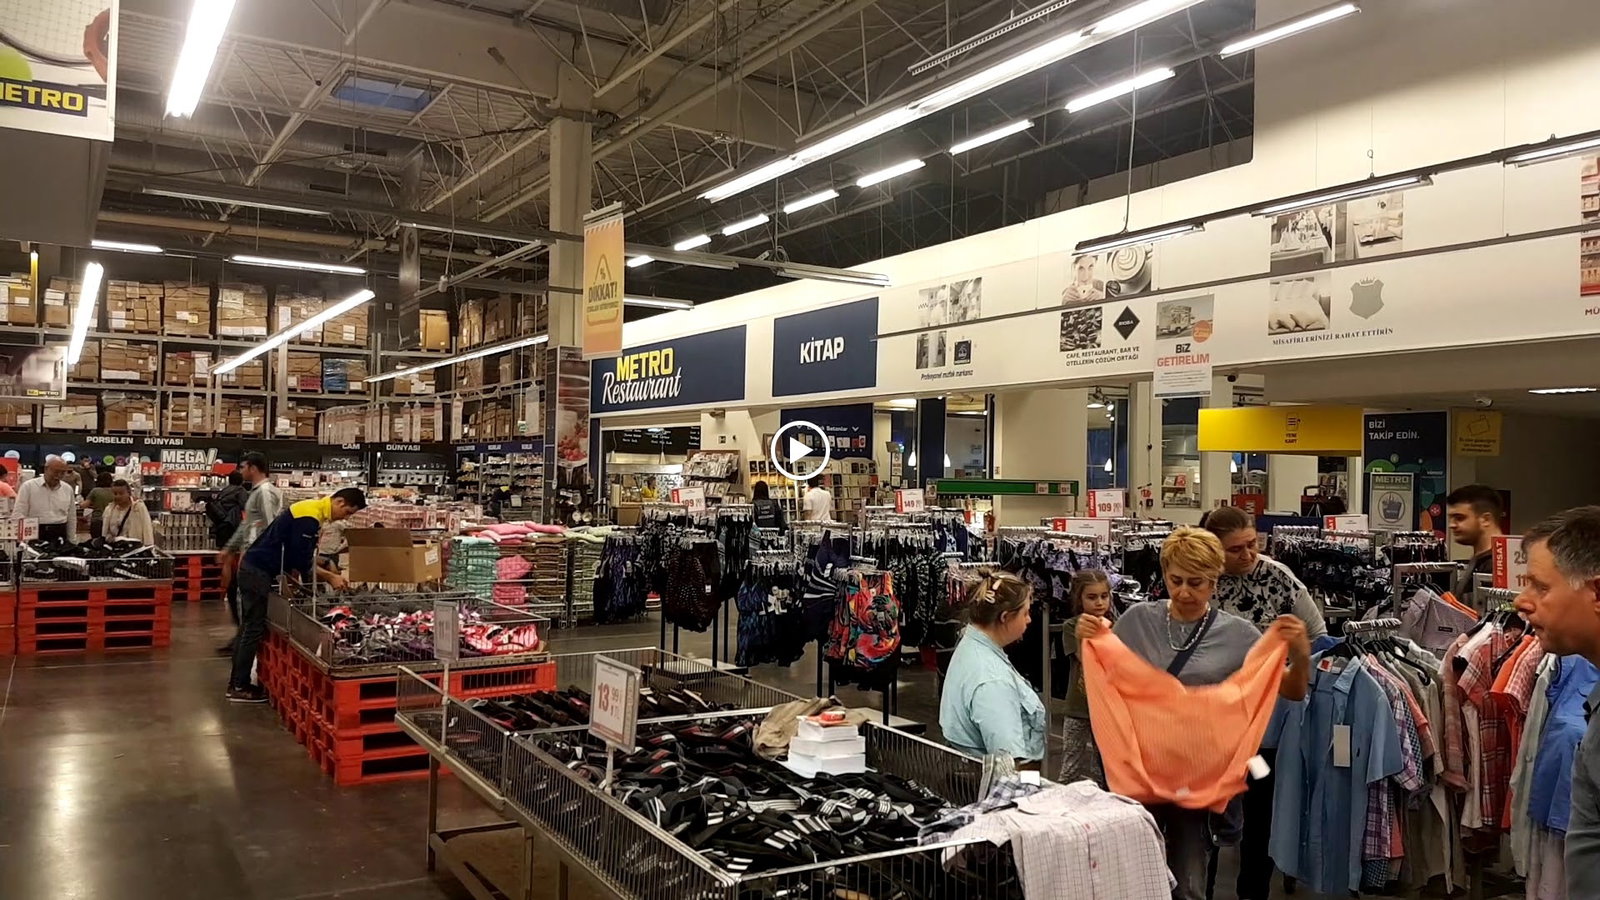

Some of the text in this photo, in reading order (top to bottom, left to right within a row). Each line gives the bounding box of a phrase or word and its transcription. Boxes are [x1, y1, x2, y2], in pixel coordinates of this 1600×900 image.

[0, 82, 83, 111] ETRO
[1335, 331, 1360, 340] RAHAT
[800, 336, 845, 364] KİTAP
[616, 347, 674, 382] METRO
[601, 366, 682, 405] Restaurant
[86, 436, 184, 446] PORSELEN DÜNYASI
[386, 443, 421, 451] DÜNYASI
[1368, 430, 1394, 440] TAKİP
[1375, 475, 1409, 484] METRO
[1496, 540, 1504, 577] FIRSAT
[597, 682, 610, 712] 13
